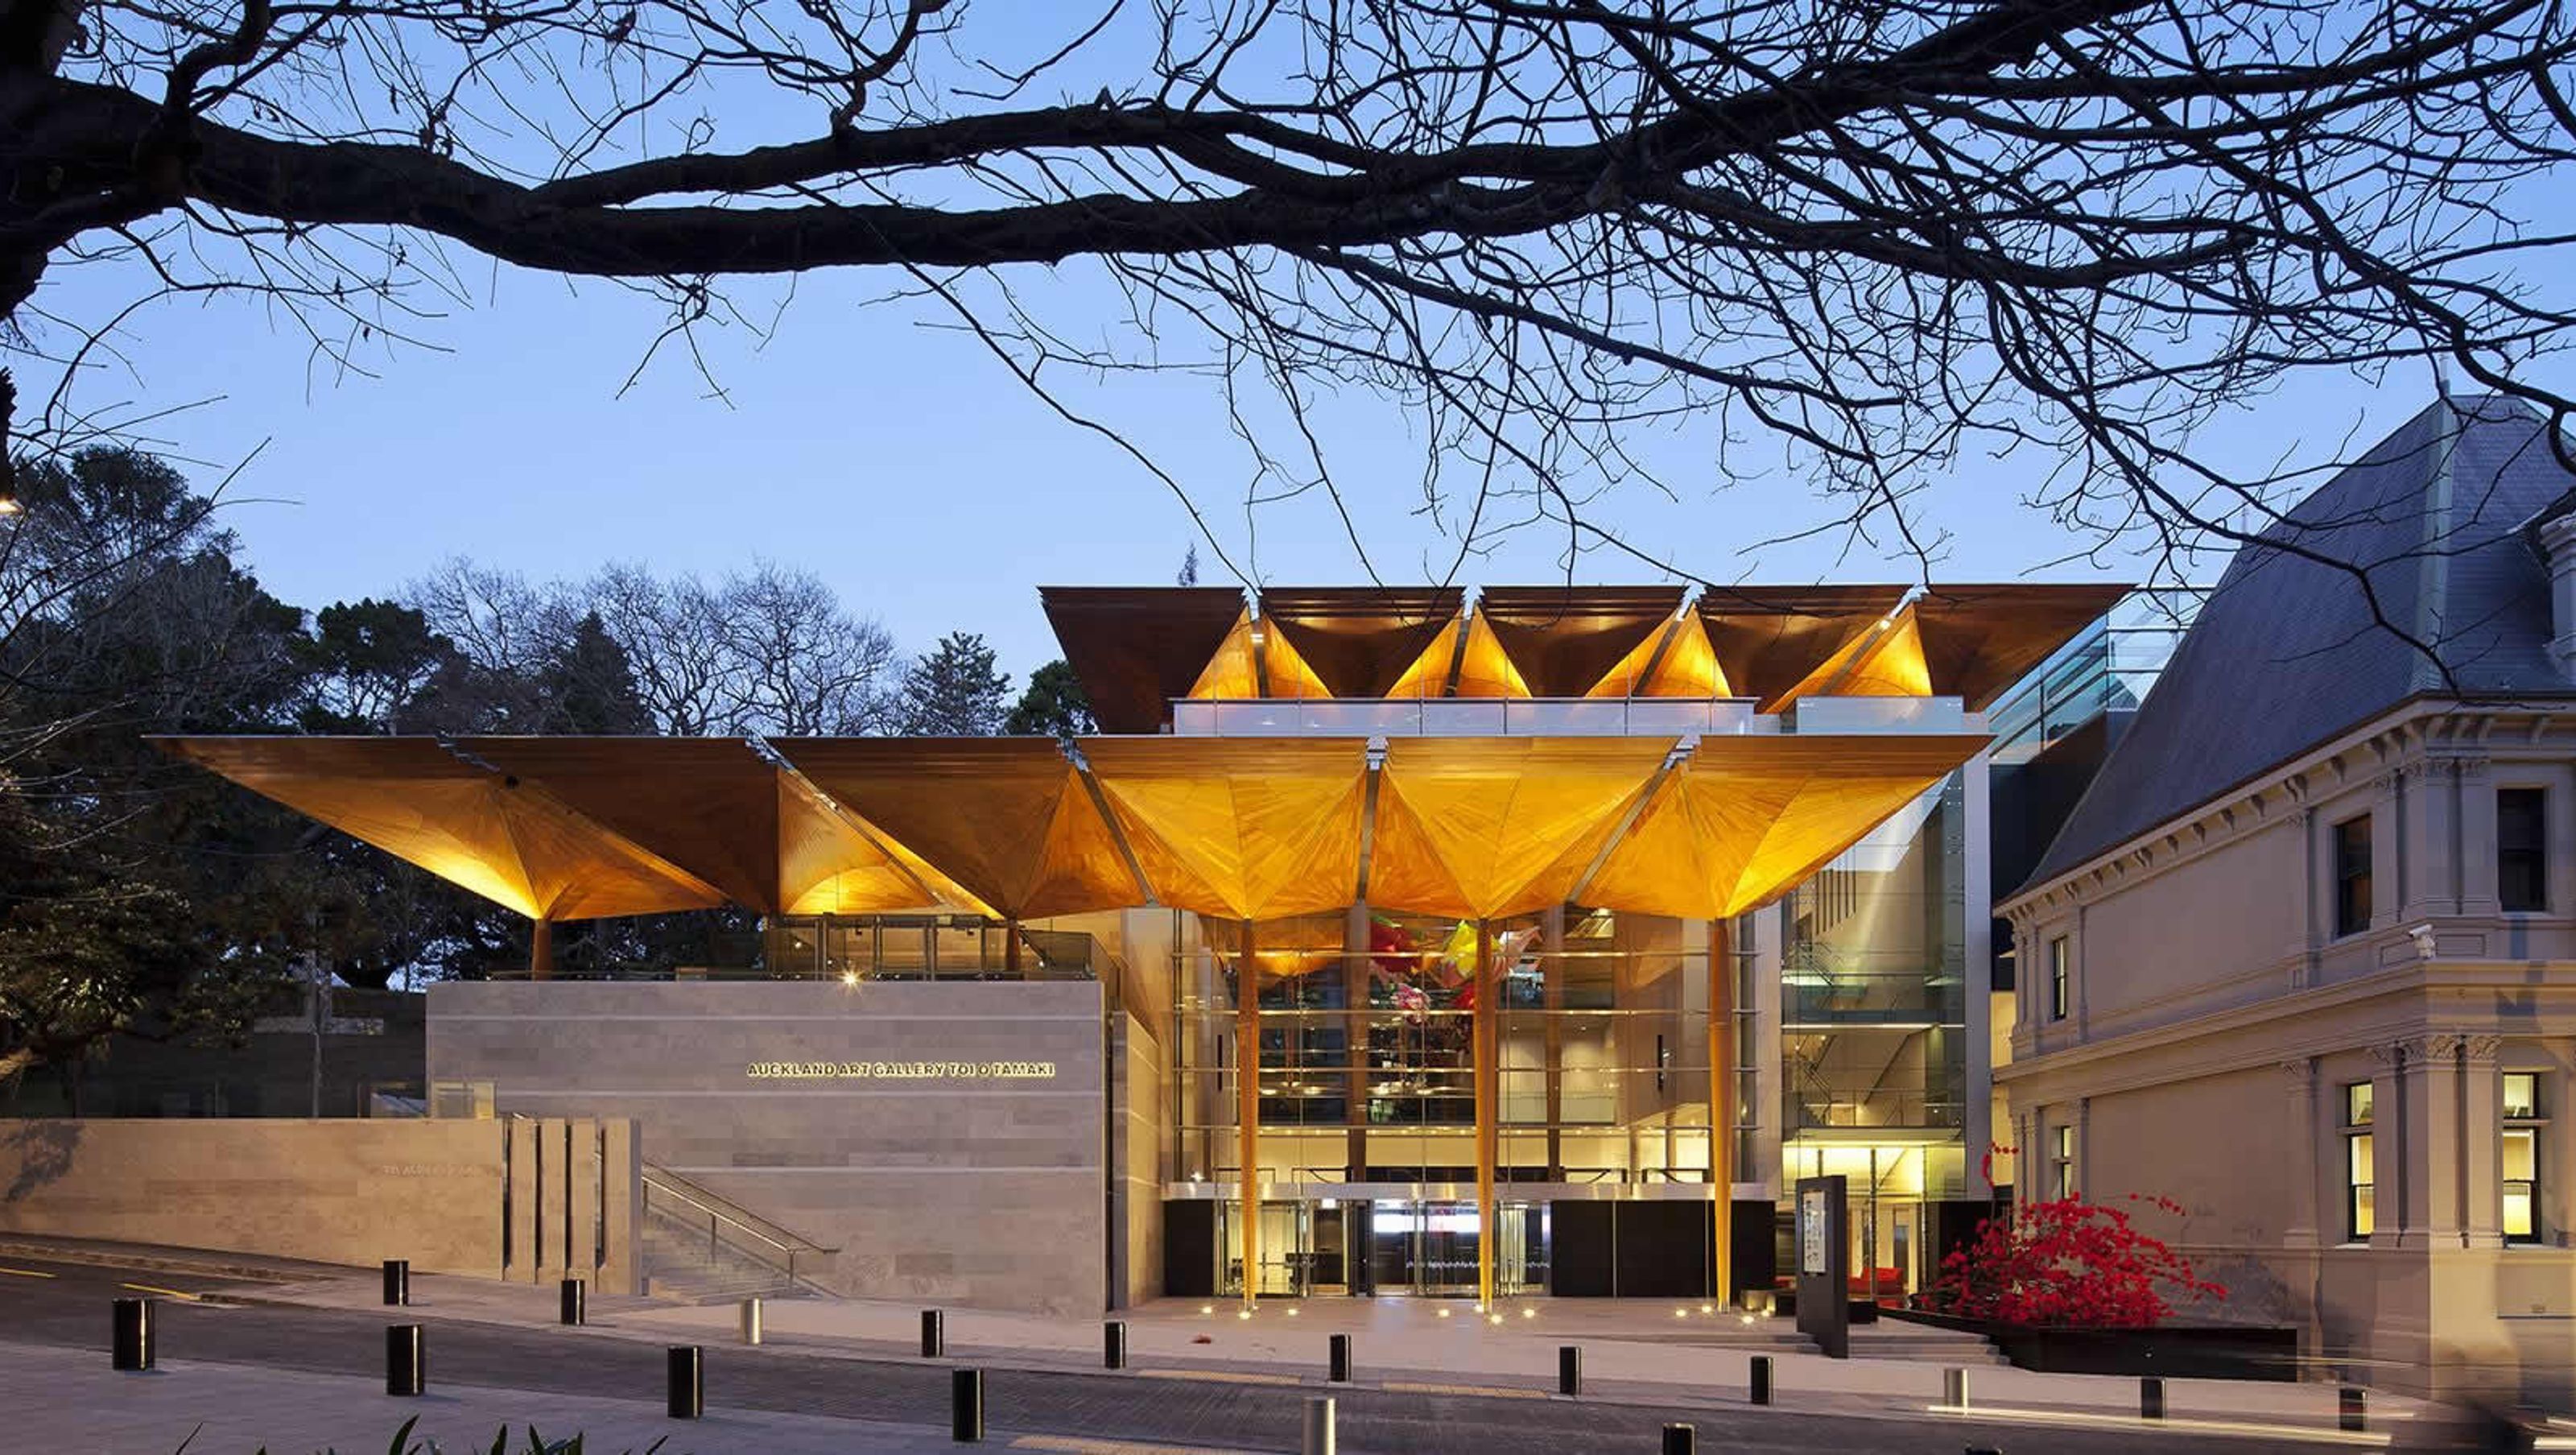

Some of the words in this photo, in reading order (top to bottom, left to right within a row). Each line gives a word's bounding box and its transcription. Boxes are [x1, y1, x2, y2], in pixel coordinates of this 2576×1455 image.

[748, 1062, 836, 1076] AUCKLAND
[839, 1062, 869, 1076] ART
[874, 1062, 944, 1076] GALLERY
[949, 1062, 975, 1076] TOI
[978, 1062, 989, 1076] O
